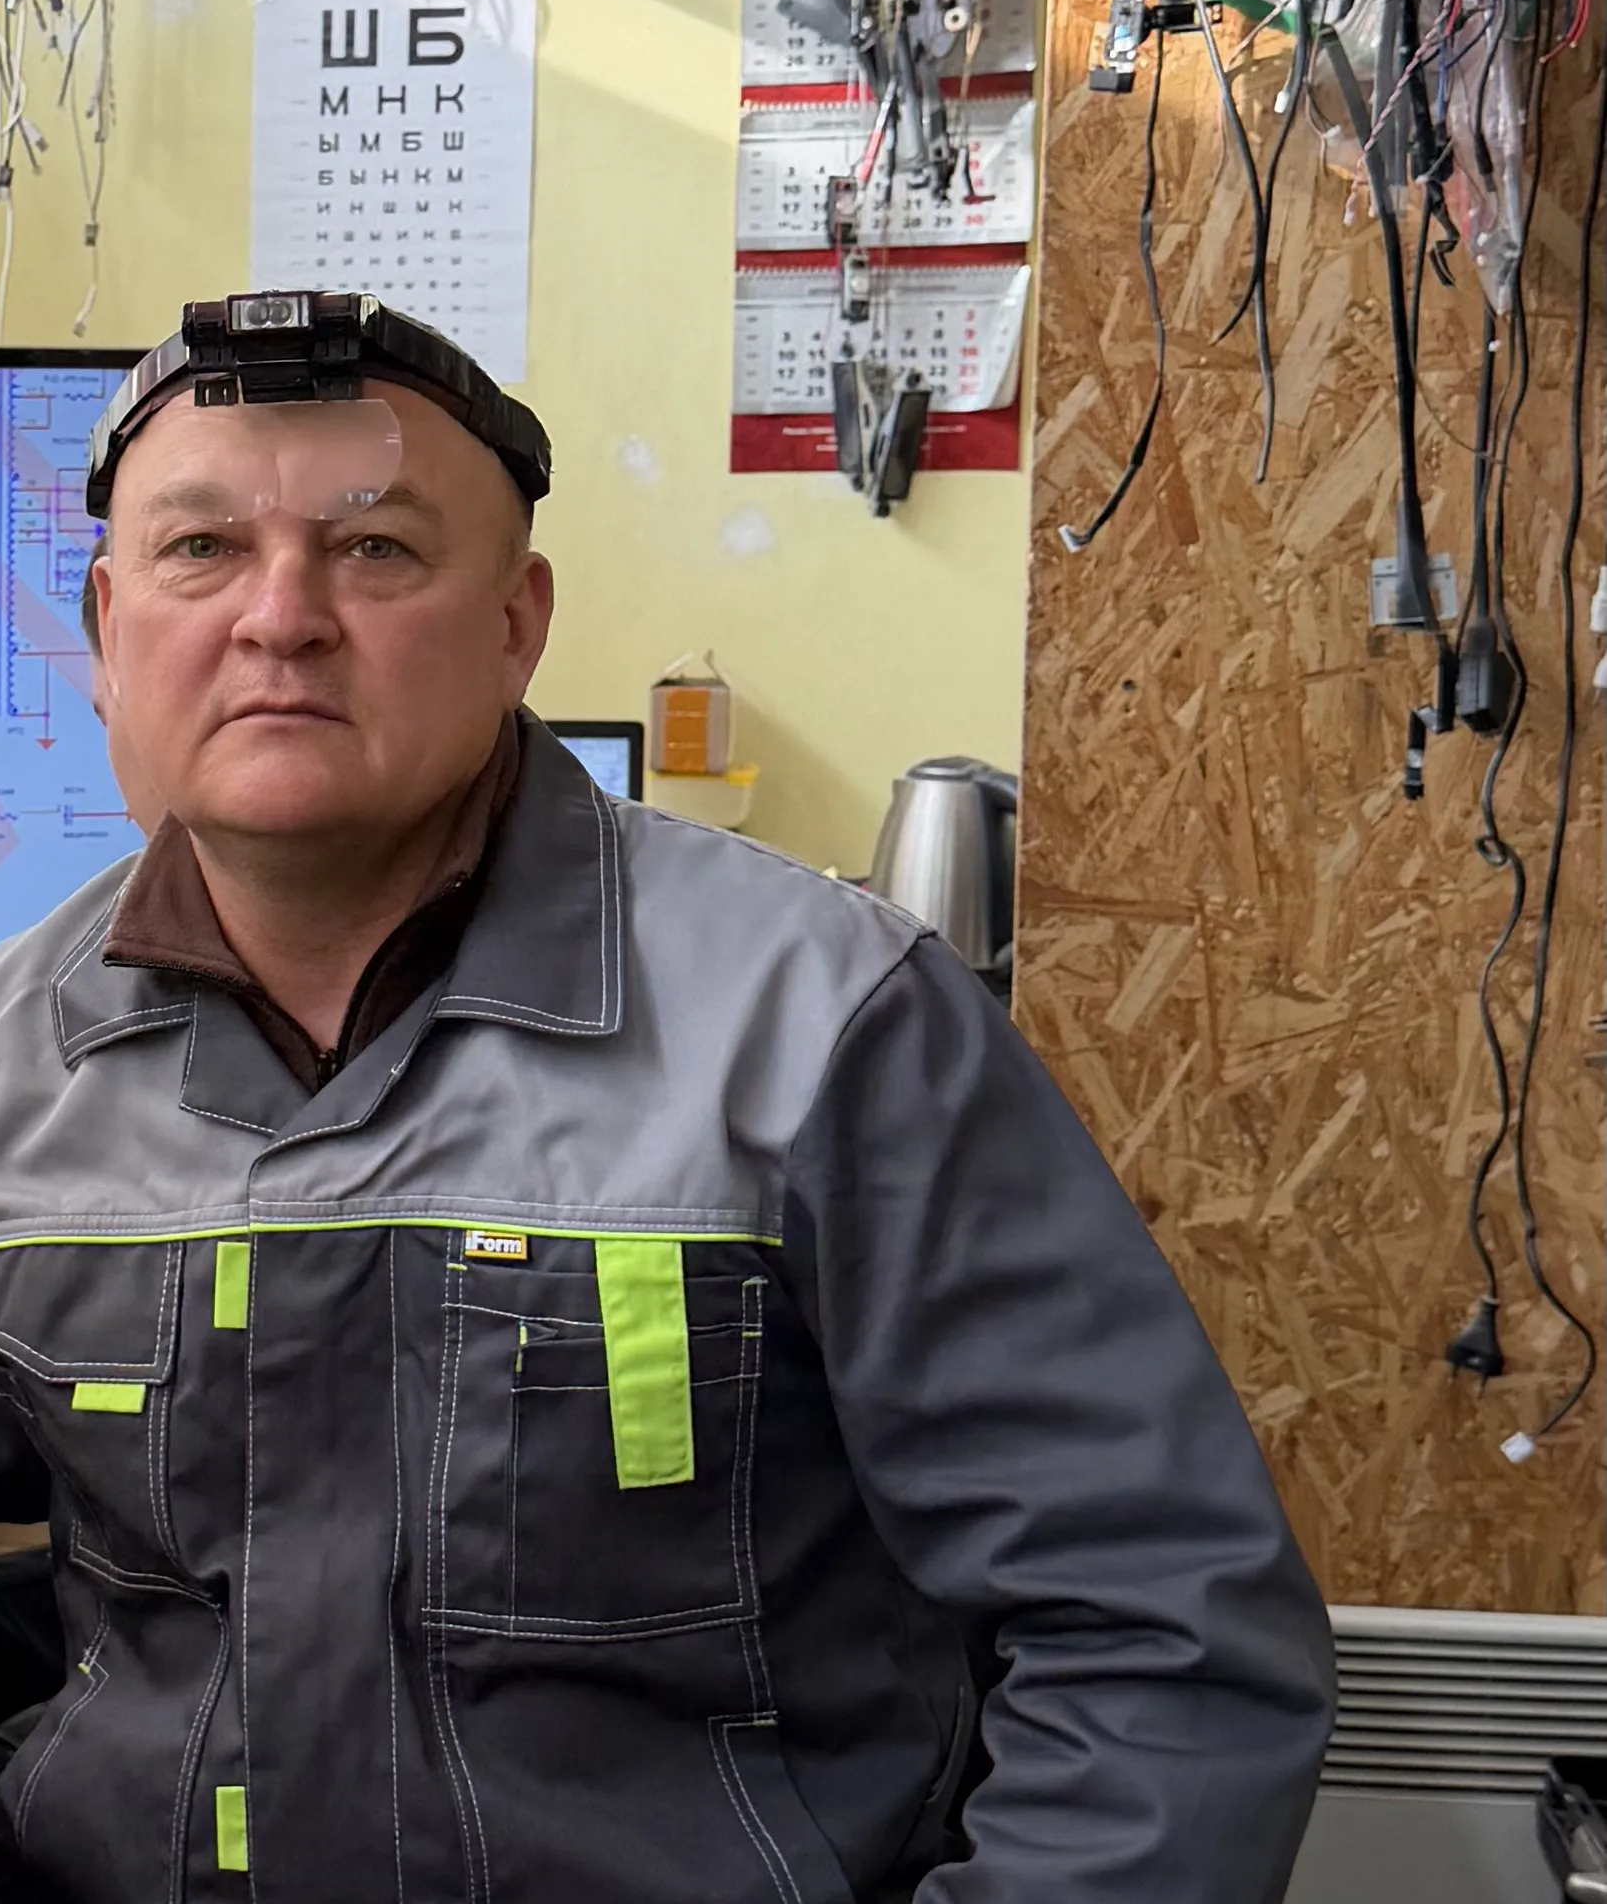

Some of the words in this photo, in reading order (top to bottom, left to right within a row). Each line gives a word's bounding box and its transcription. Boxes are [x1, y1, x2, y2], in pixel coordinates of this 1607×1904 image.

[321, 8, 379, 68] Ш
[408, 7, 466, 66] Б
[320, 85, 349, 116] М
[377, 84, 406, 115] Н
[435, 84, 465, 113] К
[319, 133, 339, 153] Ы
[360, 132, 381, 153] М
[401, 131, 424, 153] Б
[443, 131, 464, 152] Ш
